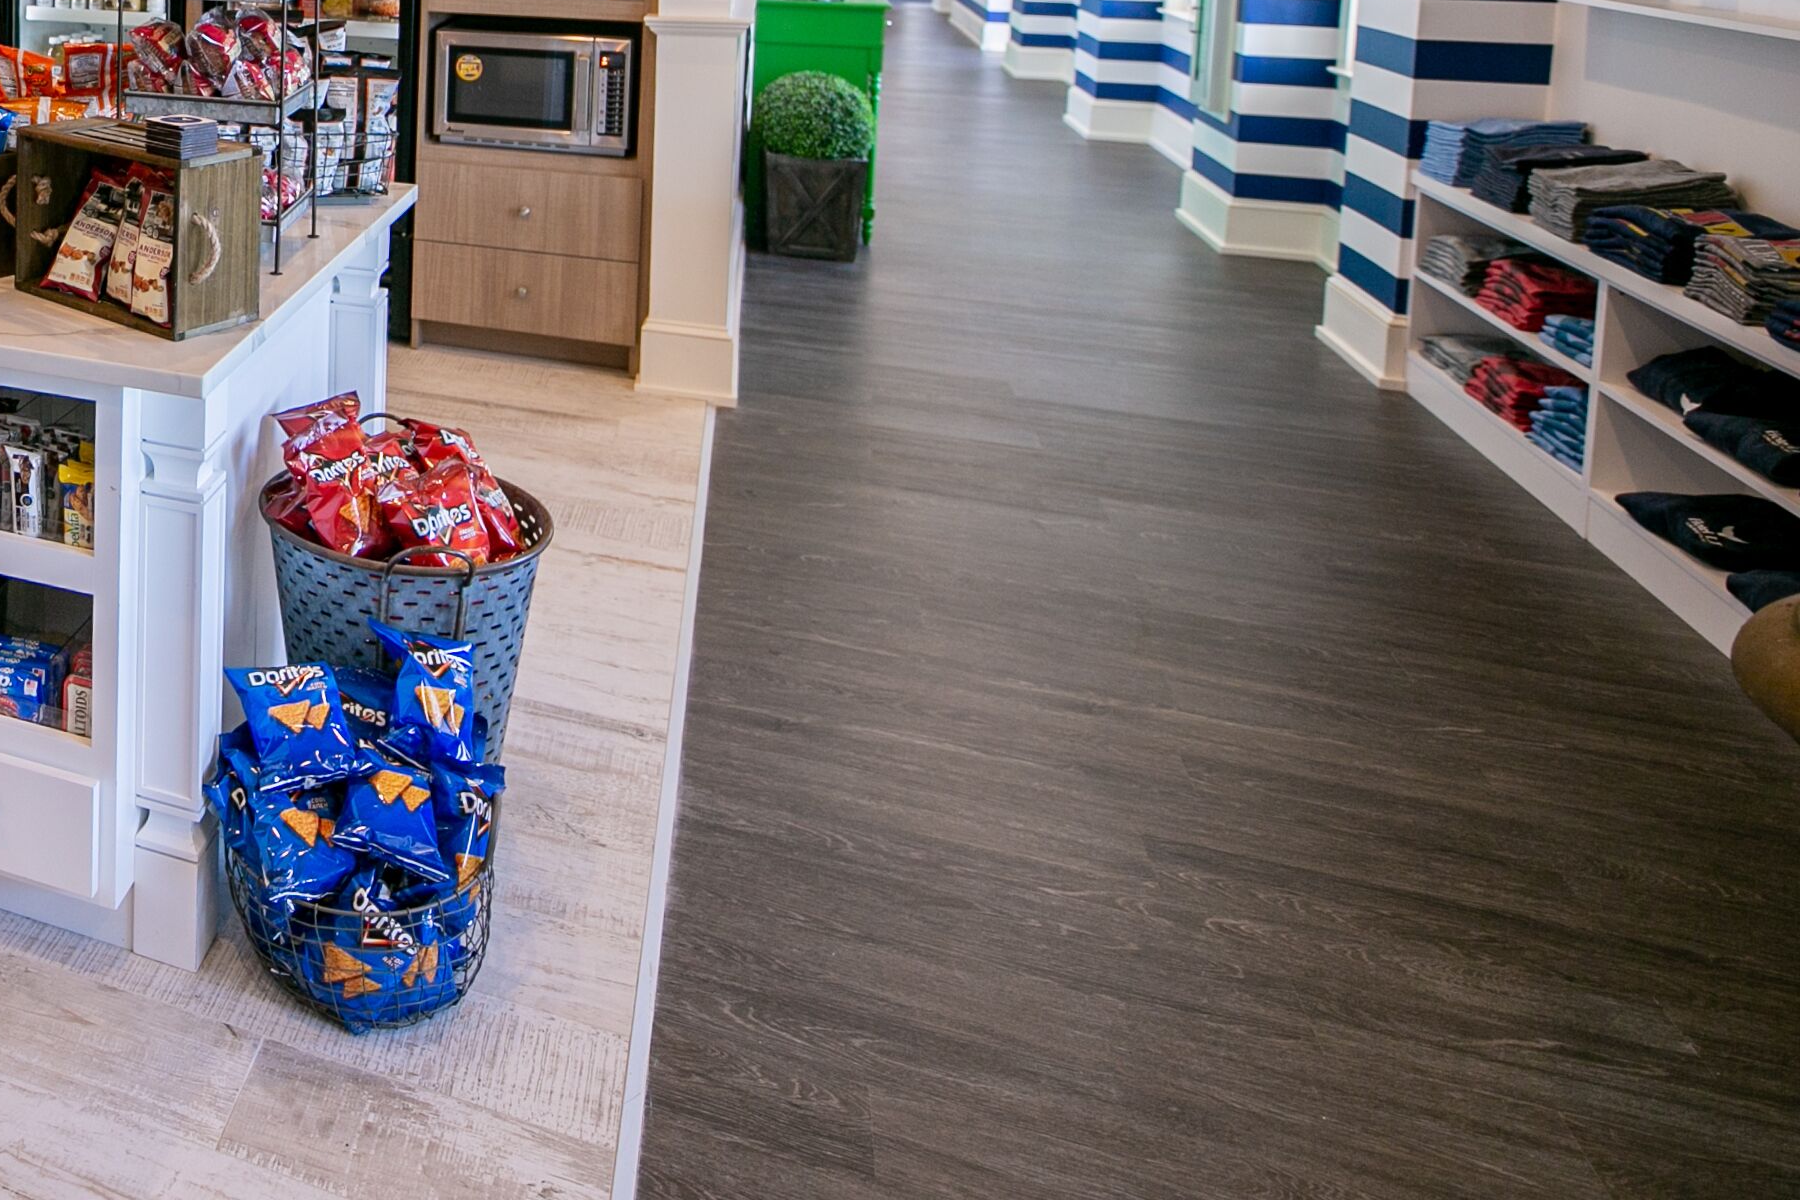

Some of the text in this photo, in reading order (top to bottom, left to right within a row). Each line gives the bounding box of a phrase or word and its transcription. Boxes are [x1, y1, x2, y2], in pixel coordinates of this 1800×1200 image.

[75, 220, 116, 240] ANDERSON
[308, 450, 367, 484] Doritos
[411, 503, 473, 541] Doritos
[248, 663, 325, 687] Doritos
[412, 647, 470, 673] oritos
[75, 690, 88, 732] LTOIDS
[342, 701, 387, 727] ritos
[460, 791, 492, 822] Dori
[352, 887, 418, 955] Doritos
